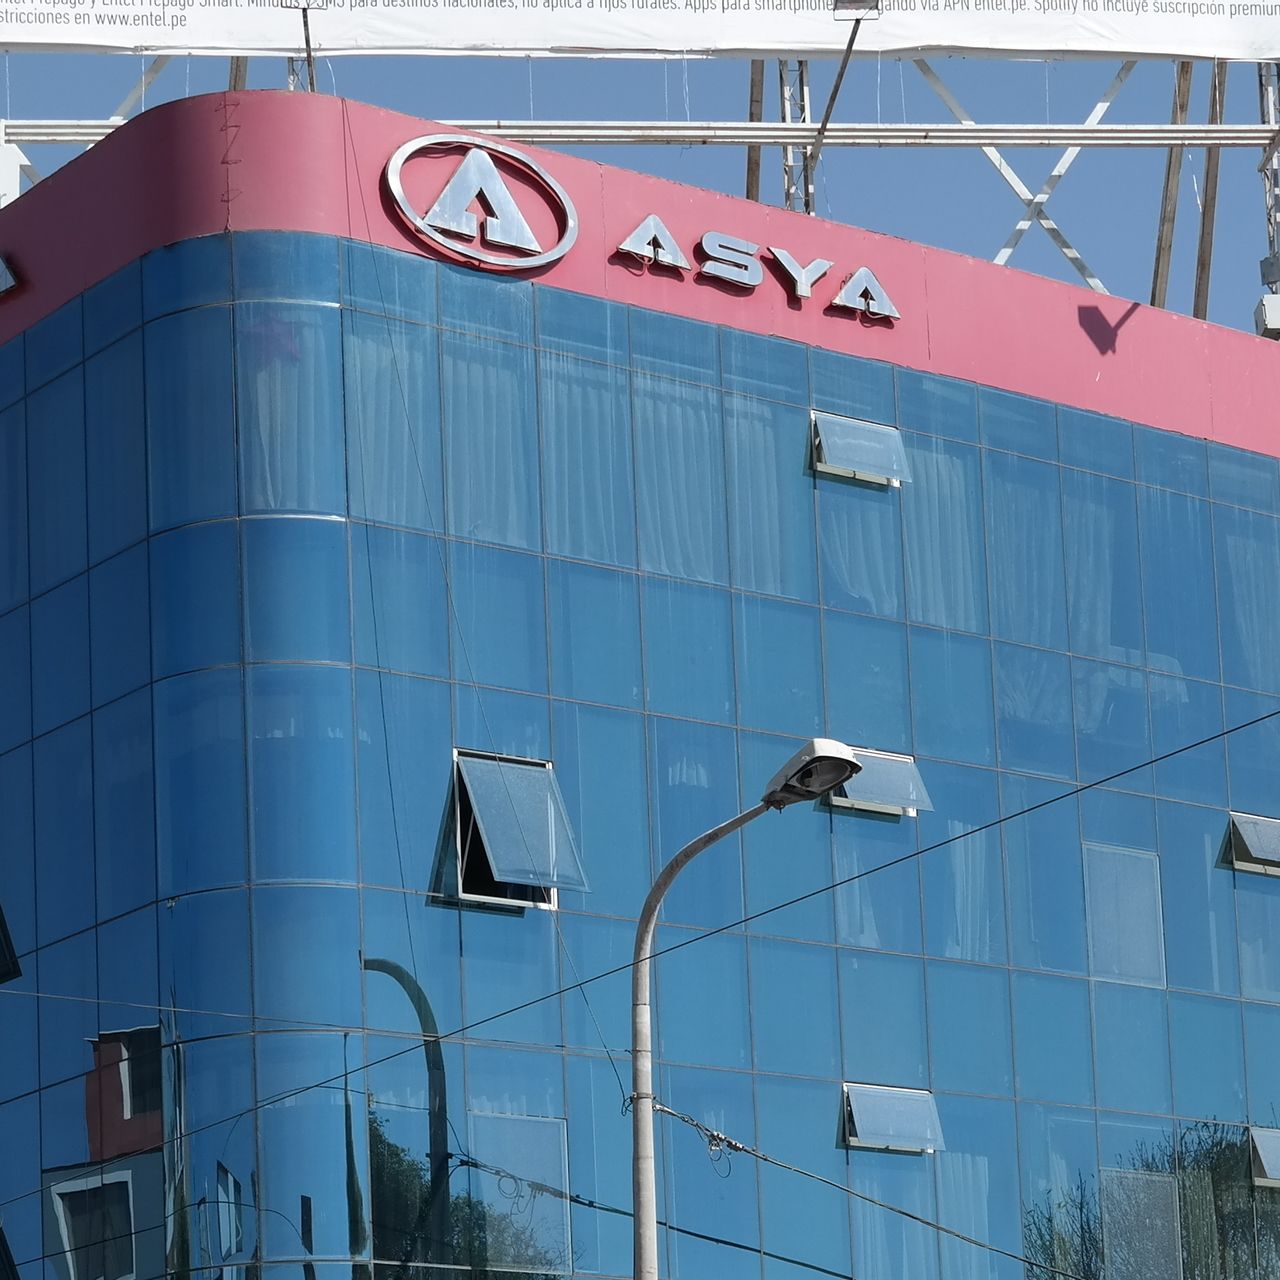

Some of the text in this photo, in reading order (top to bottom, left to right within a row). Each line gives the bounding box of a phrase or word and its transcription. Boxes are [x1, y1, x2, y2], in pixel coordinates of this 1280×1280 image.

[74, 12, 91, 25] en
[95, 9, 188, 30] www.entel.pe
[616, 212, 902, 321] ASYA
